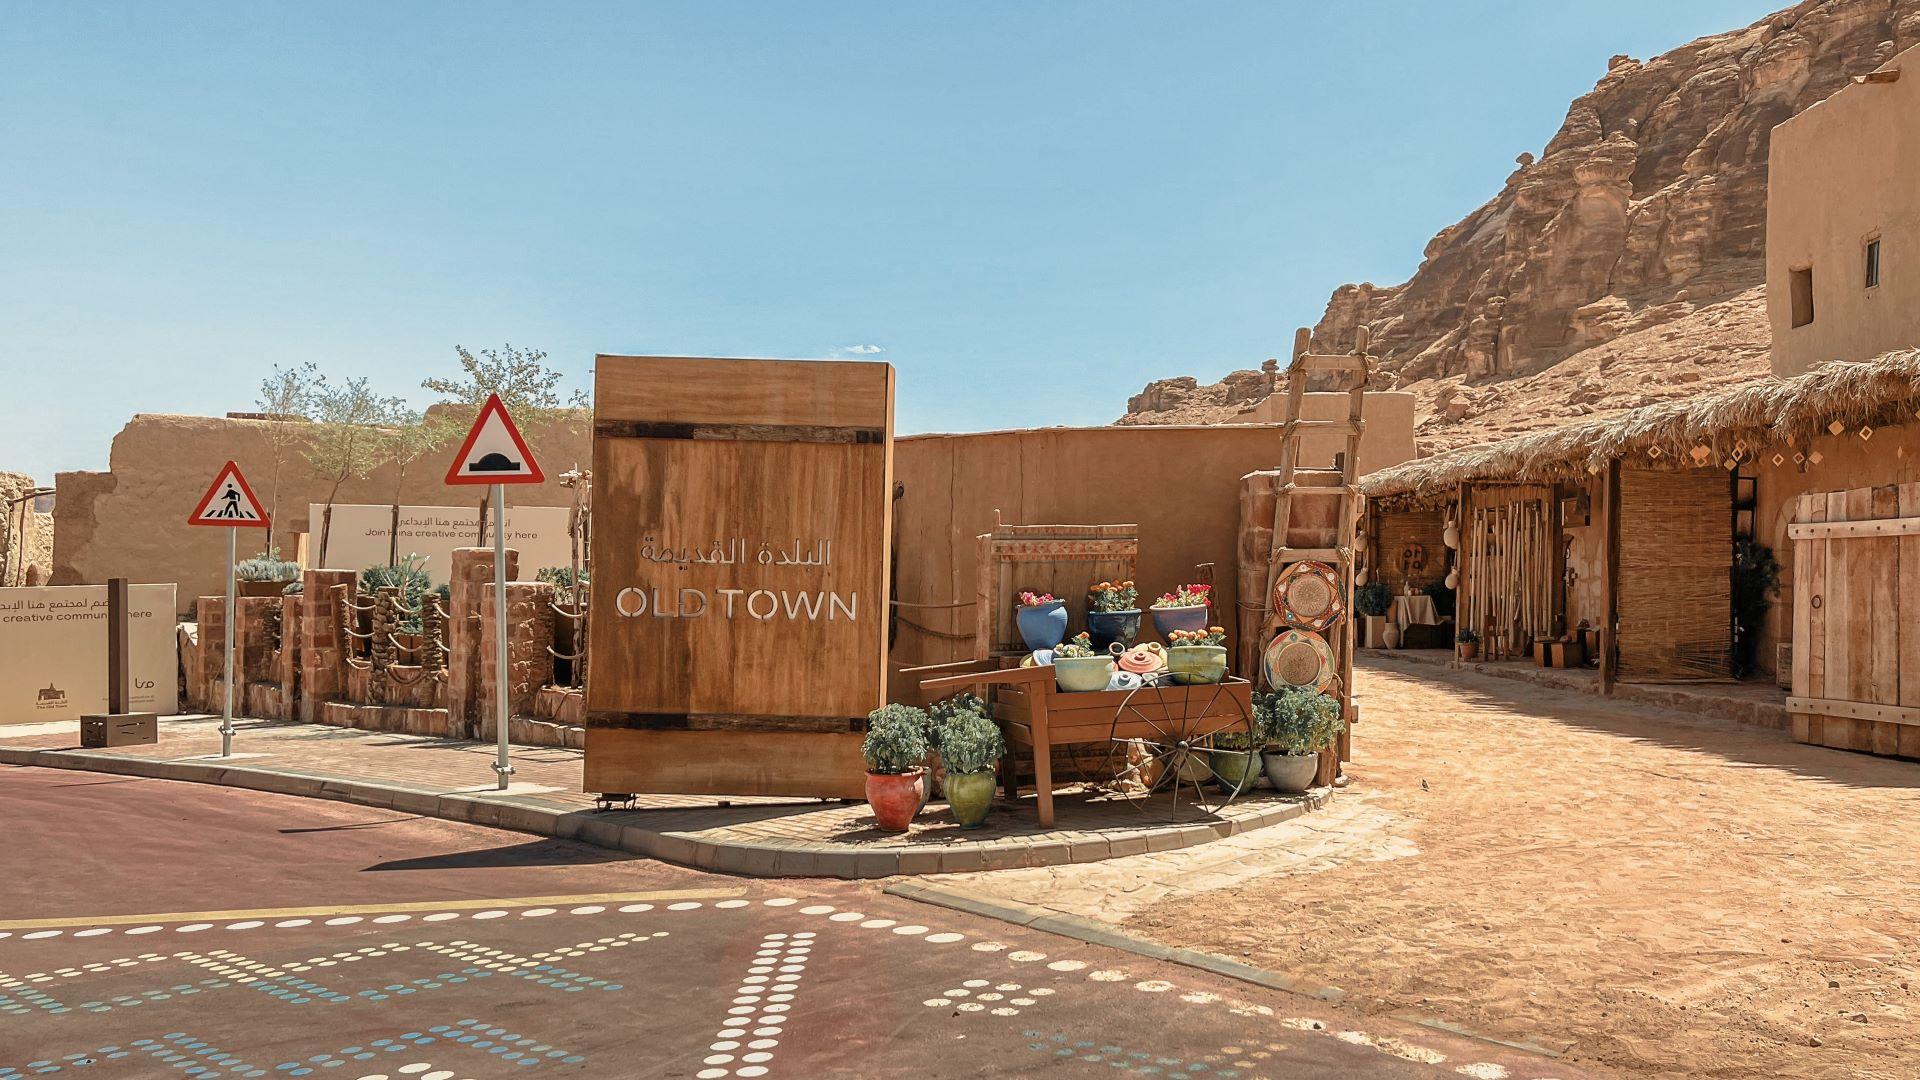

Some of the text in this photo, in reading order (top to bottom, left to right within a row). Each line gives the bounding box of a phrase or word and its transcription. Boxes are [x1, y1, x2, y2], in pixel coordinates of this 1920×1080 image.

[364, 528, 386, 537] Join
[387, 528, 413, 537] Hna
[415, 529, 456, 538] creative
[514, 531, 538, 539] here
[640, 536, 832, 573] البلدة القديمة
[615, 586, 857, 621] OLD TOWN
[2, 613, 54, 623] creative
[56, 612, 108, 621] commun
